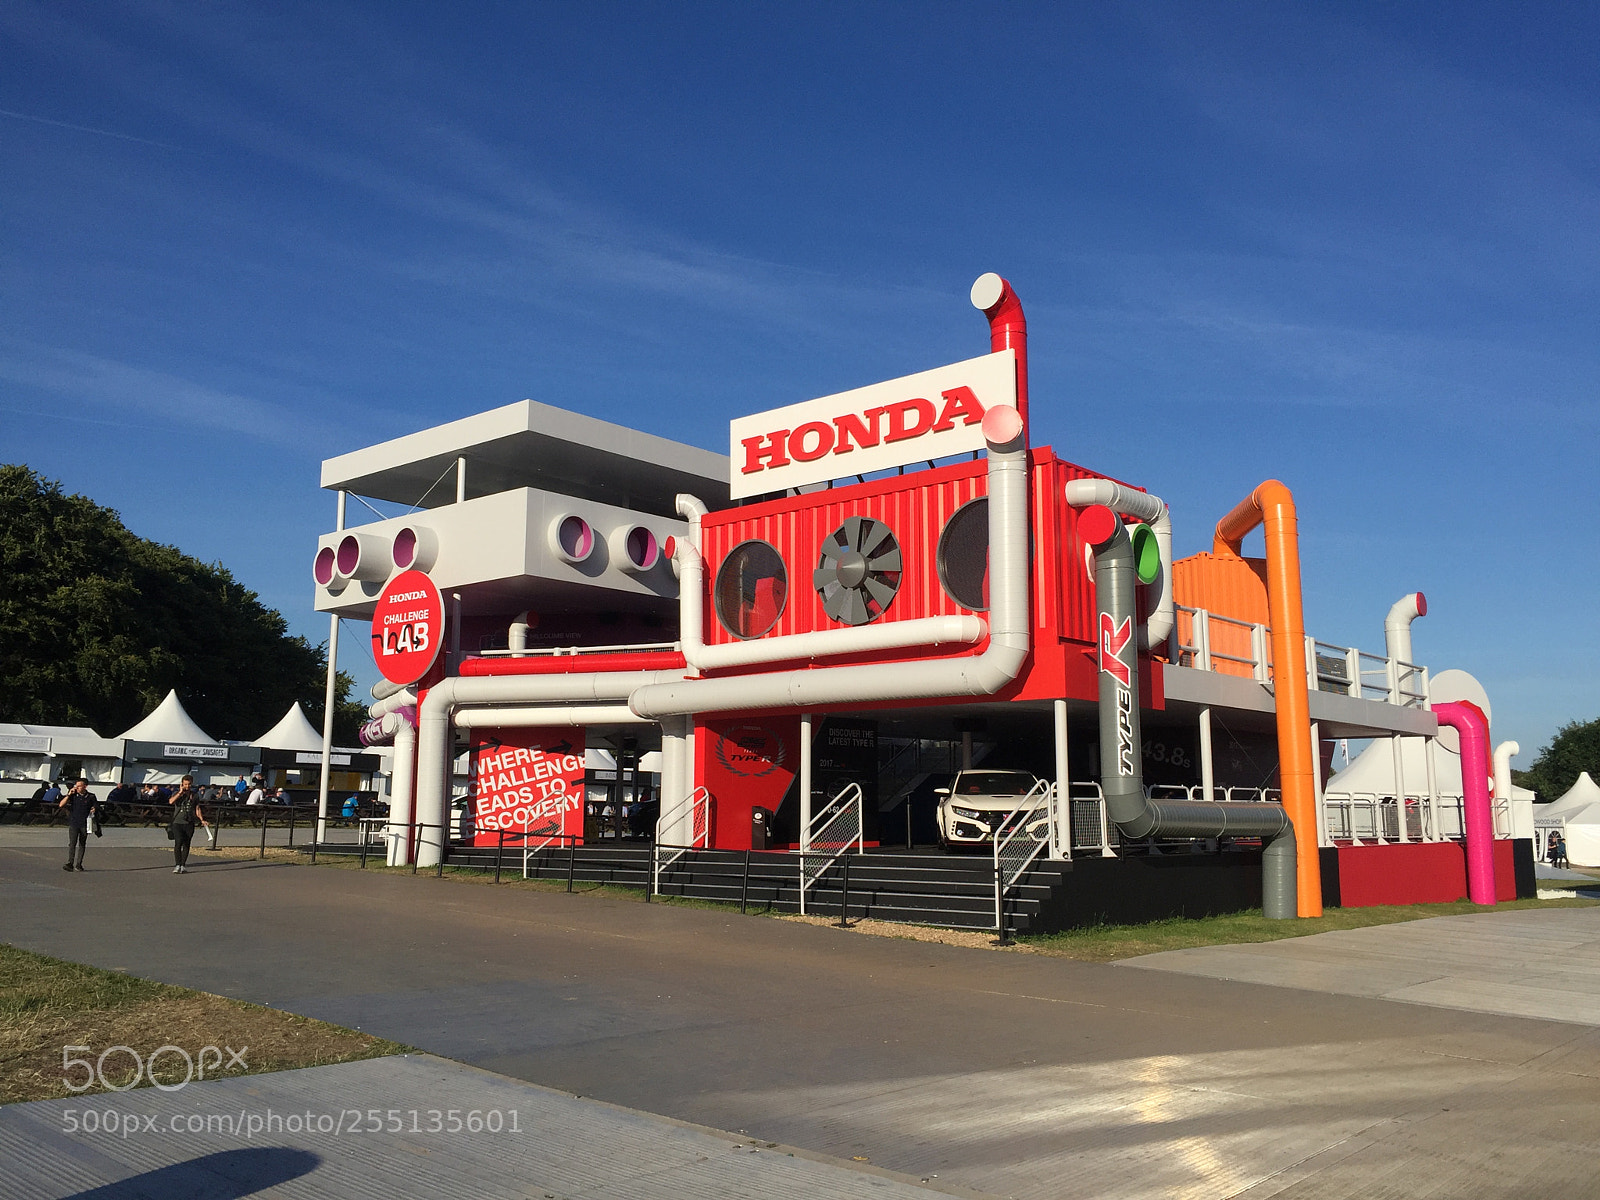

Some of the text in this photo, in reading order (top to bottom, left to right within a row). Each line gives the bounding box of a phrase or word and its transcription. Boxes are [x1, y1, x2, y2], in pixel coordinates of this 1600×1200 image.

[741, 385, 986, 474] HONDA
[388, 590, 428, 604] HONDA
[383, 609, 430, 625] CHALLENGE
[382, 622, 429, 656] LAB
[1100, 612, 1134, 775] TYPE R
[828, 737, 874, 748] LATEST TYPE R
[829, 728, 875, 739] DISCOVER THE
[169, 747, 225, 757] ORGANIC SAUSAGES
[469, 744, 544, 777] WHERE
[731, 754, 773, 763] TYPE R
[819, 759, 833, 768] 2017
[468, 752, 586, 797] CHALLENGE
[465, 778, 567, 819] LEADS TO
[466, 791, 581, 839] DISCOVERY
